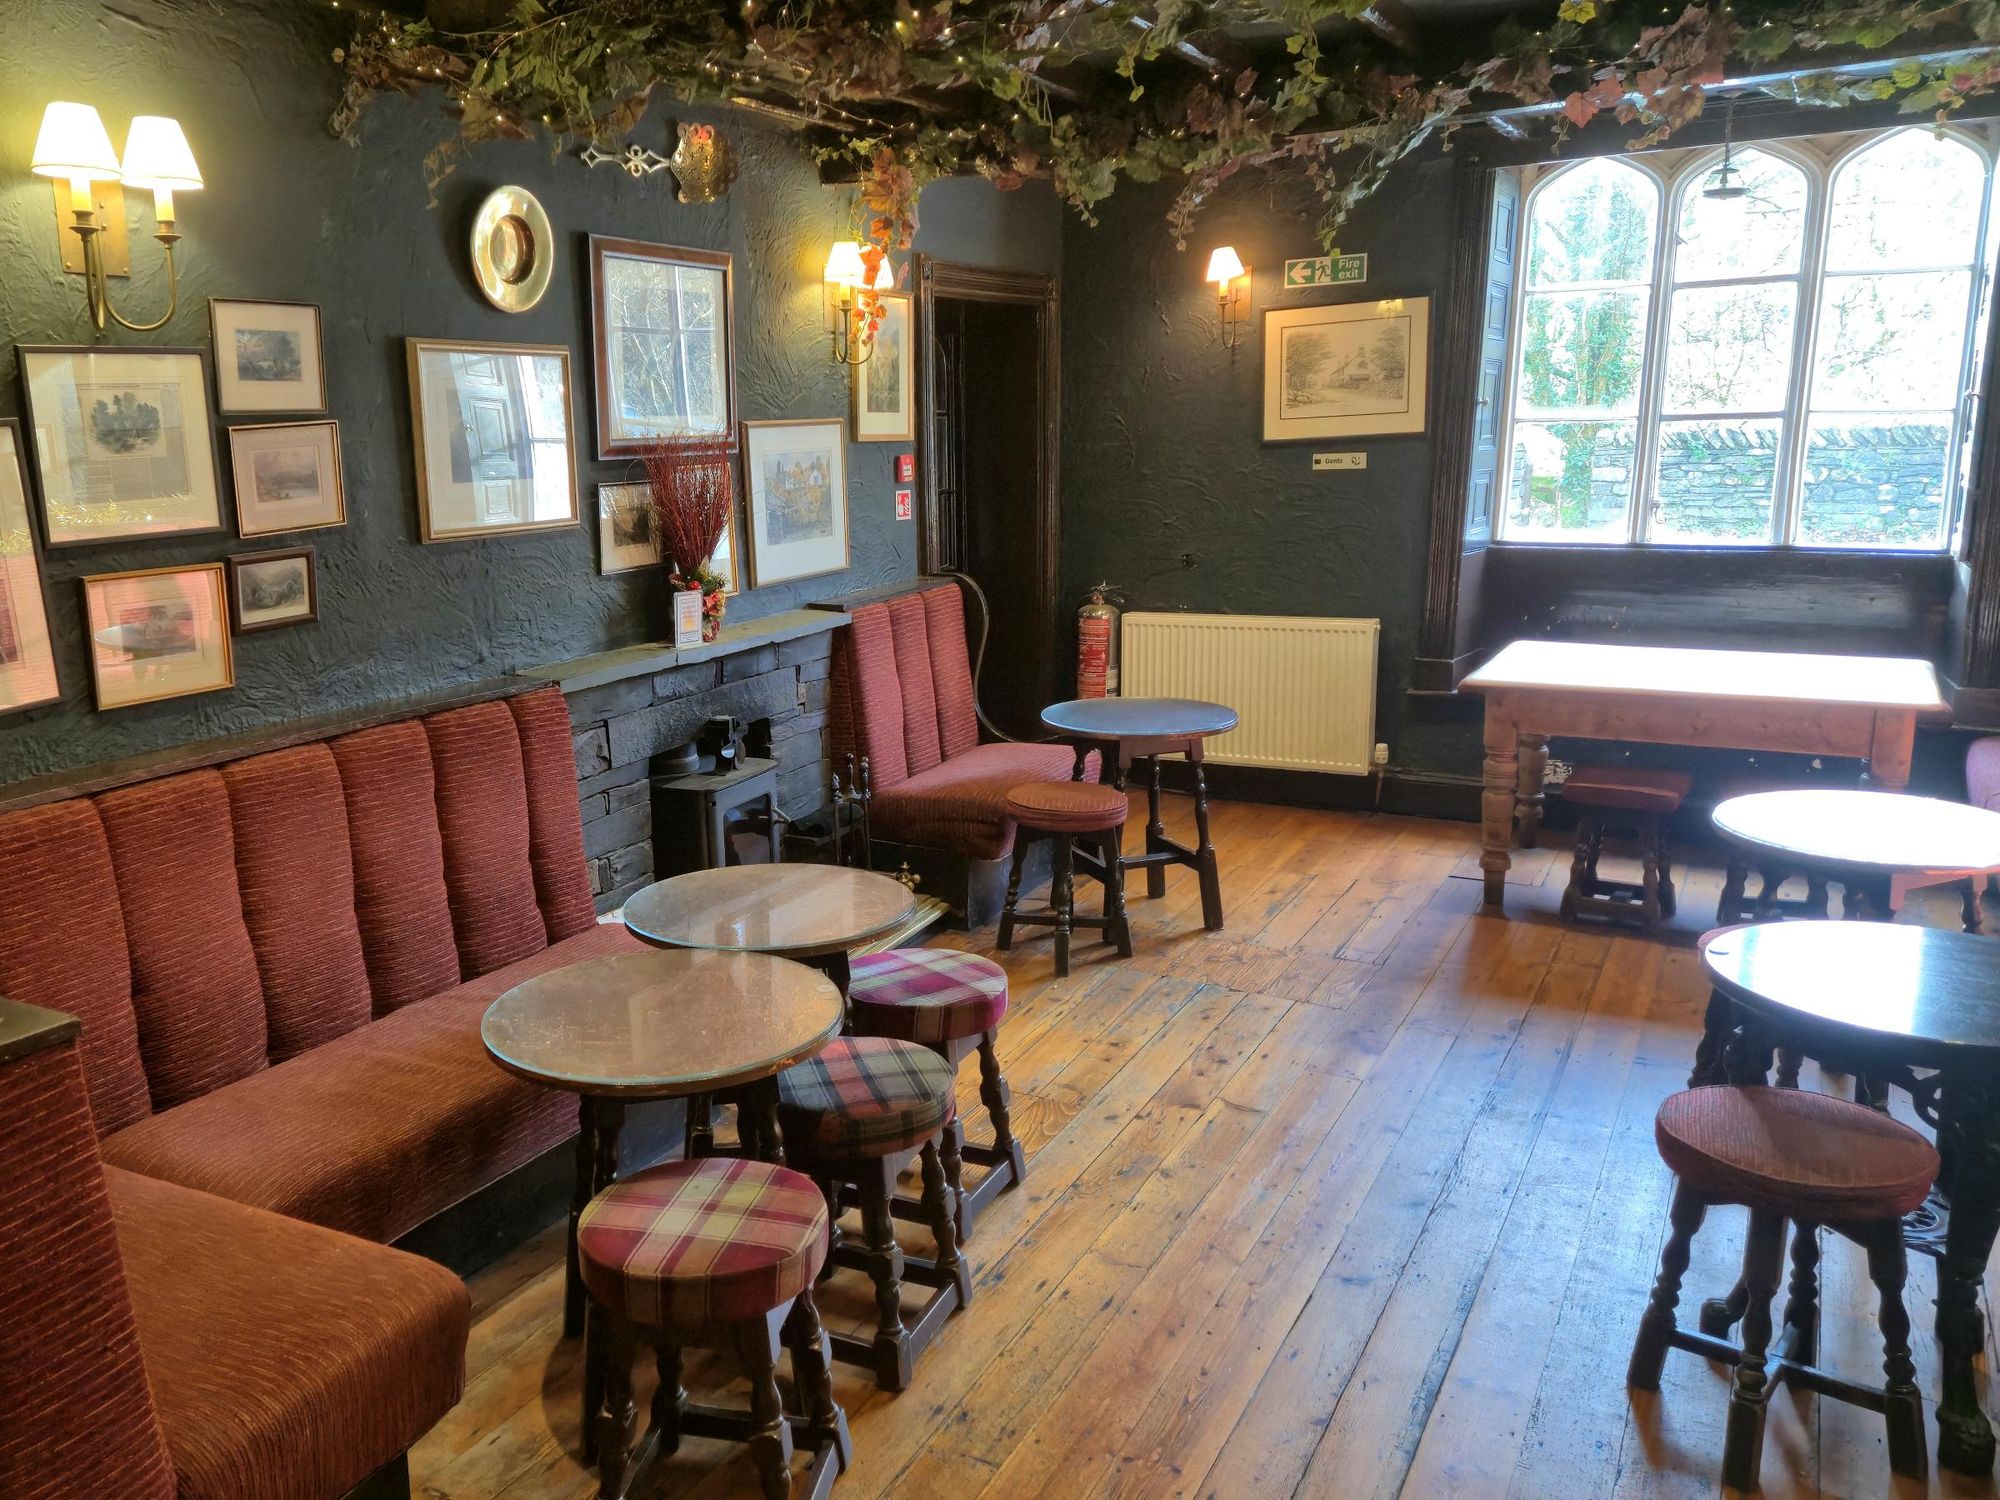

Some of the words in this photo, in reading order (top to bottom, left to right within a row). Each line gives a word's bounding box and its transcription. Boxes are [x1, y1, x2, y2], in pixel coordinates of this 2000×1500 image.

[1338, 258, 1360, 269] Fire
[1338, 269, 1359, 279] exit
[1325, 457, 1343, 465] Gents
